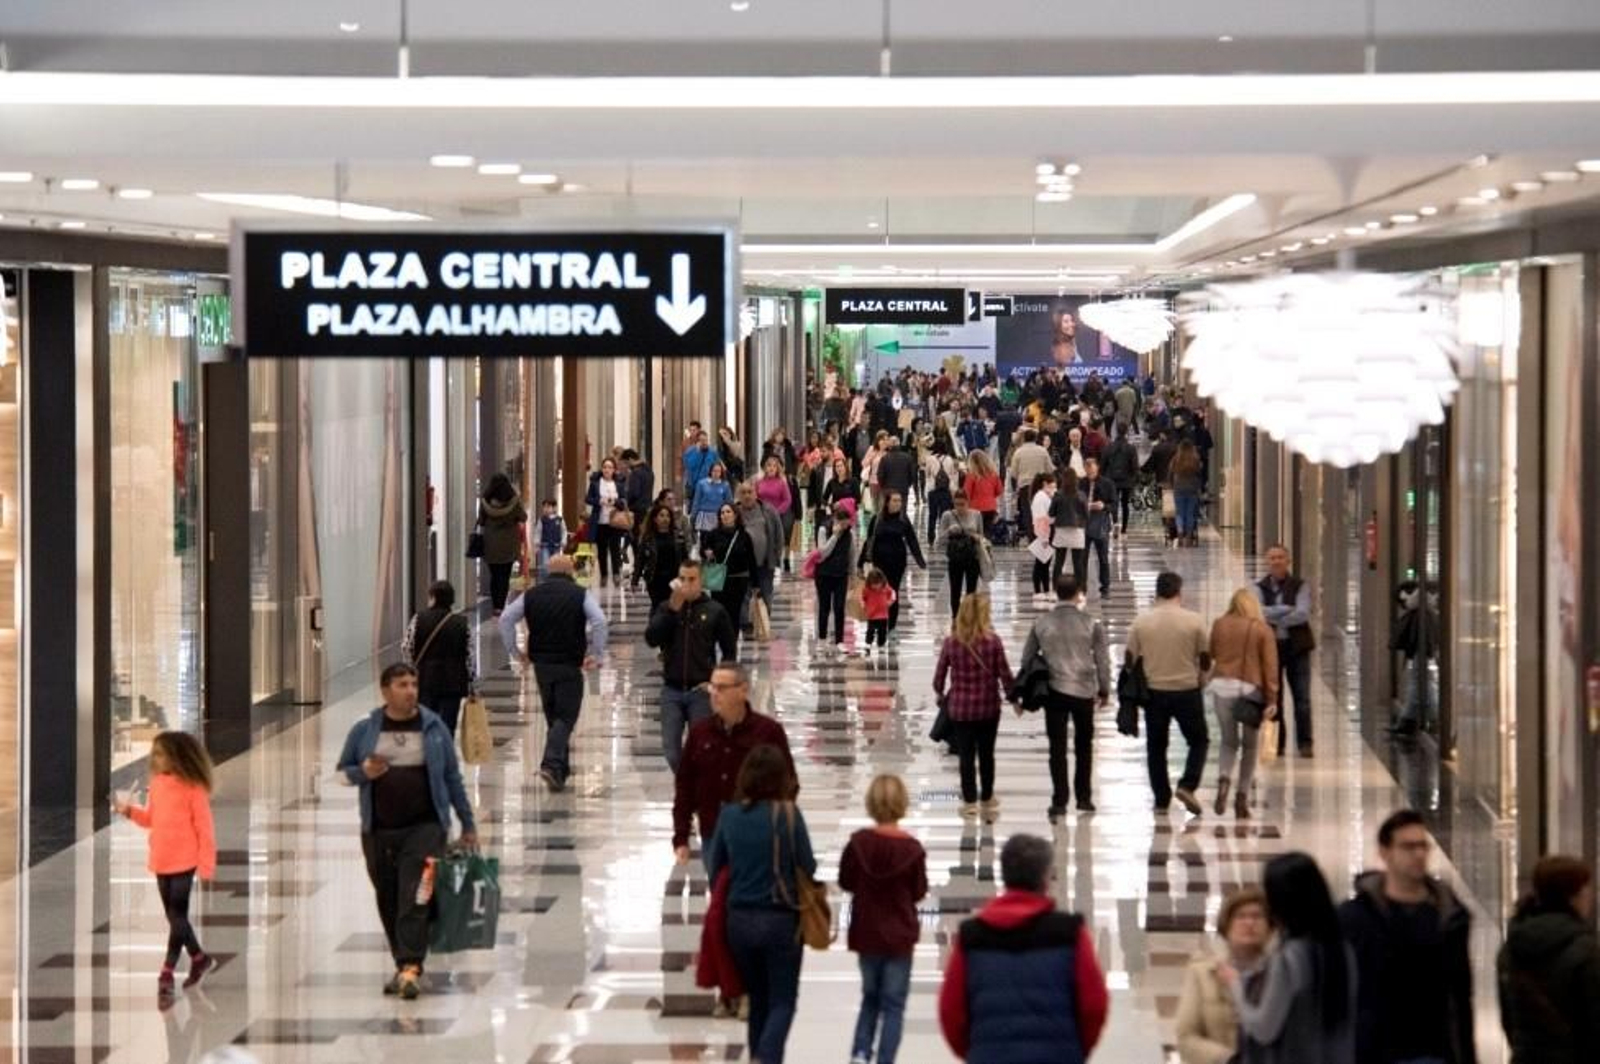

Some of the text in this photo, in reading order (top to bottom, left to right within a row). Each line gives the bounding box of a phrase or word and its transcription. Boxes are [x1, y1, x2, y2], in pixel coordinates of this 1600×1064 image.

[280, 251, 651, 290] PLAZA CENTRAL
[841, 300, 948, 312] PLAZA CENTRAL
[1014, 301, 1049, 313] ctívate
[306, 303, 624, 337] PLAZA ALHAMBRA
